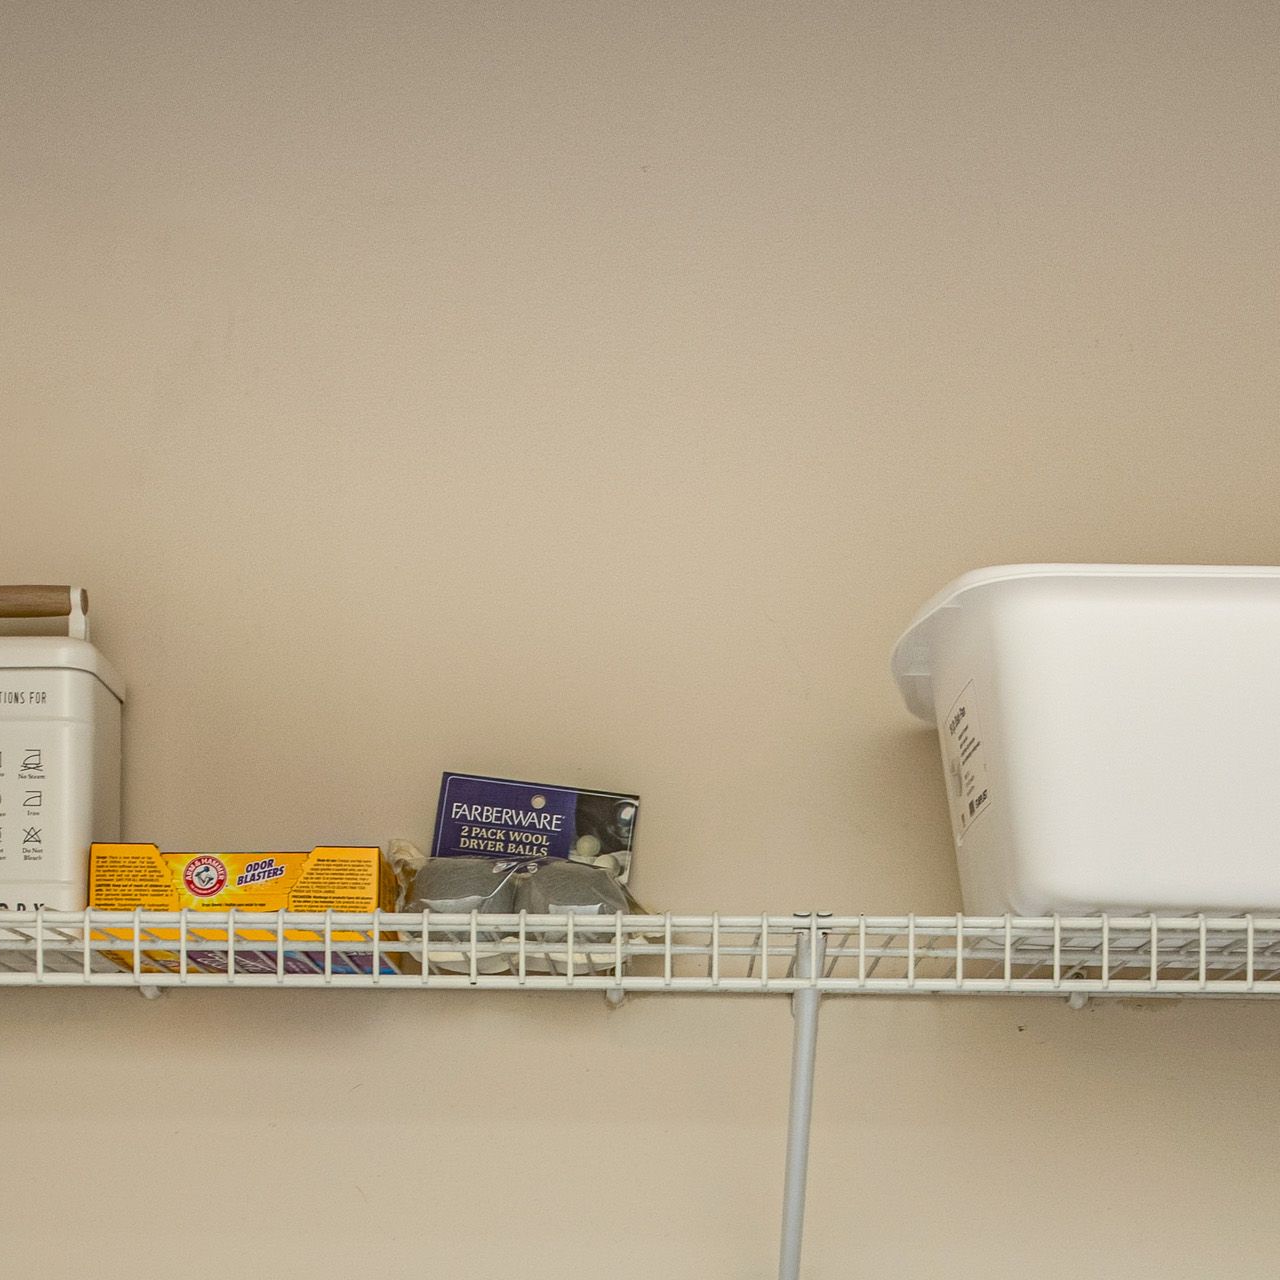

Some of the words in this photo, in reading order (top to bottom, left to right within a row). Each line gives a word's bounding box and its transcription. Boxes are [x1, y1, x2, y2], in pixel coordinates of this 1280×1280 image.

[29, 692, 47, 705] FOR
[451, 802, 563, 832] FARBERWARE
[460, 826, 469, 836] 2
[471, 827, 506, 841] PACK
[509, 831, 550, 846] WOOL
[459, 837, 504, 852] DRYER
[507, 843, 548, 857] BALLS
[185, 862, 196, 881] ARM
[201, 857, 225, 881] HAMMER
[237, 865, 285, 886] BLASTERS
[245, 858, 275, 874] ODOR
